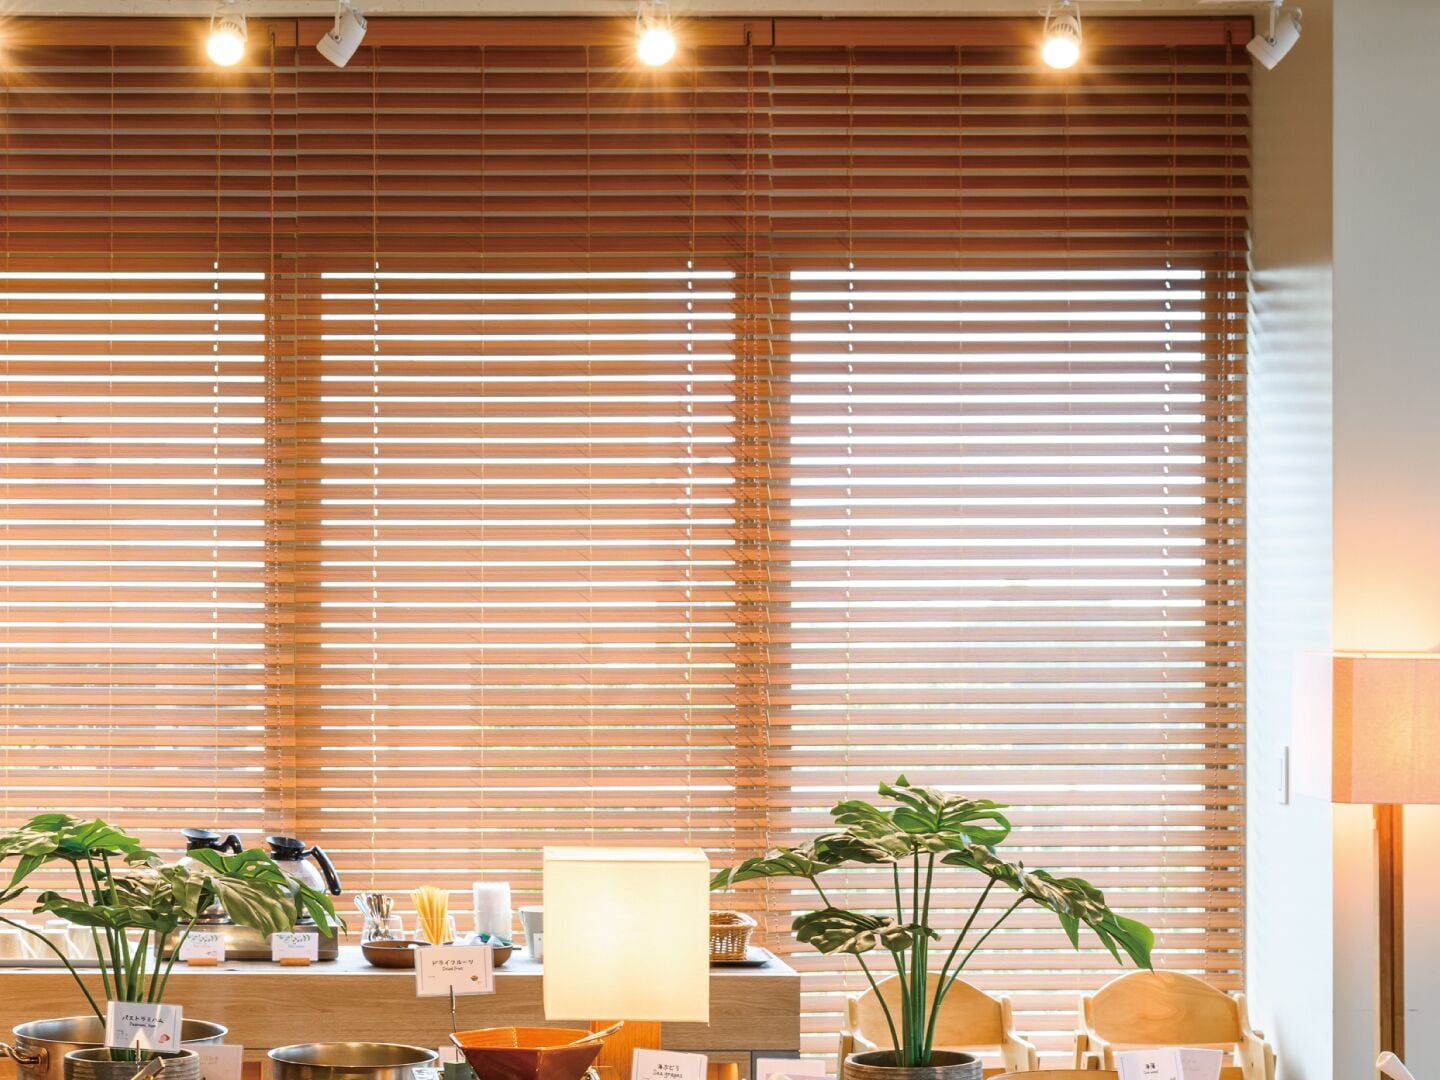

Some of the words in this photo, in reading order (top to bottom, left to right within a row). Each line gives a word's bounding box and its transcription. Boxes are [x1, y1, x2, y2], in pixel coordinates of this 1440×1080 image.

[432, 959, 474, 967] ドライフルーツ
